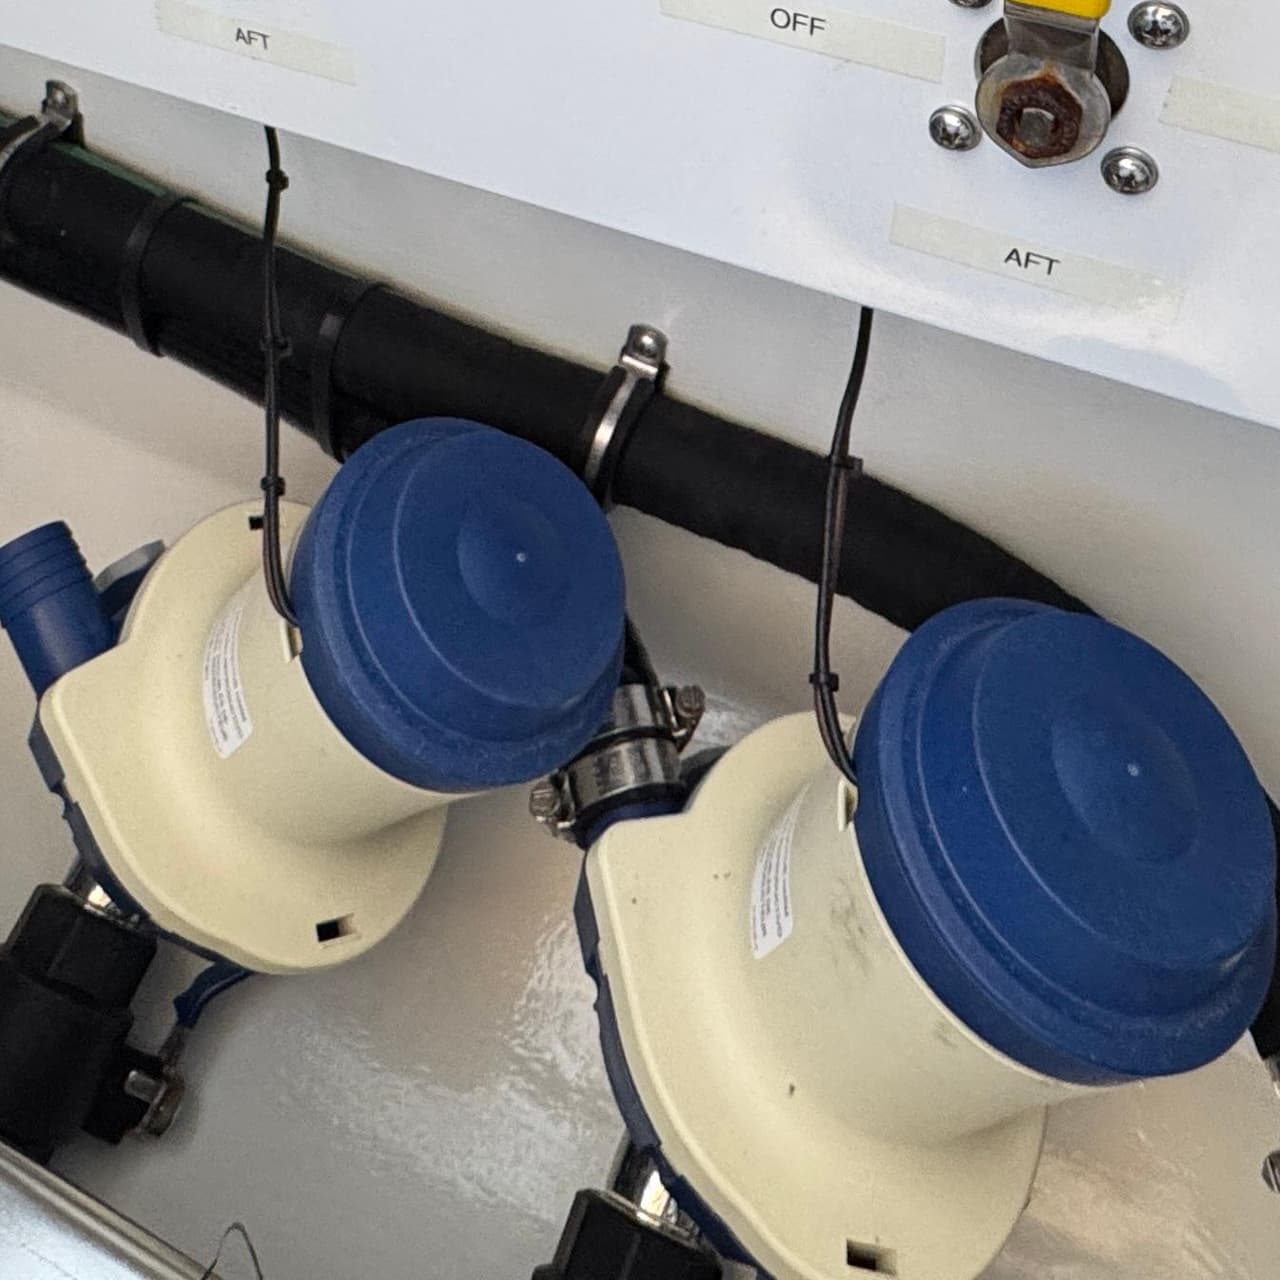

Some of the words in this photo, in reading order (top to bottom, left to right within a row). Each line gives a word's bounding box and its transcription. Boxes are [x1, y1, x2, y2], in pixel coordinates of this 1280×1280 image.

[769, 7, 827, 37] OFF
[235, 27, 270, 50] AFT
[1003, 247, 1061, 276] AFT
